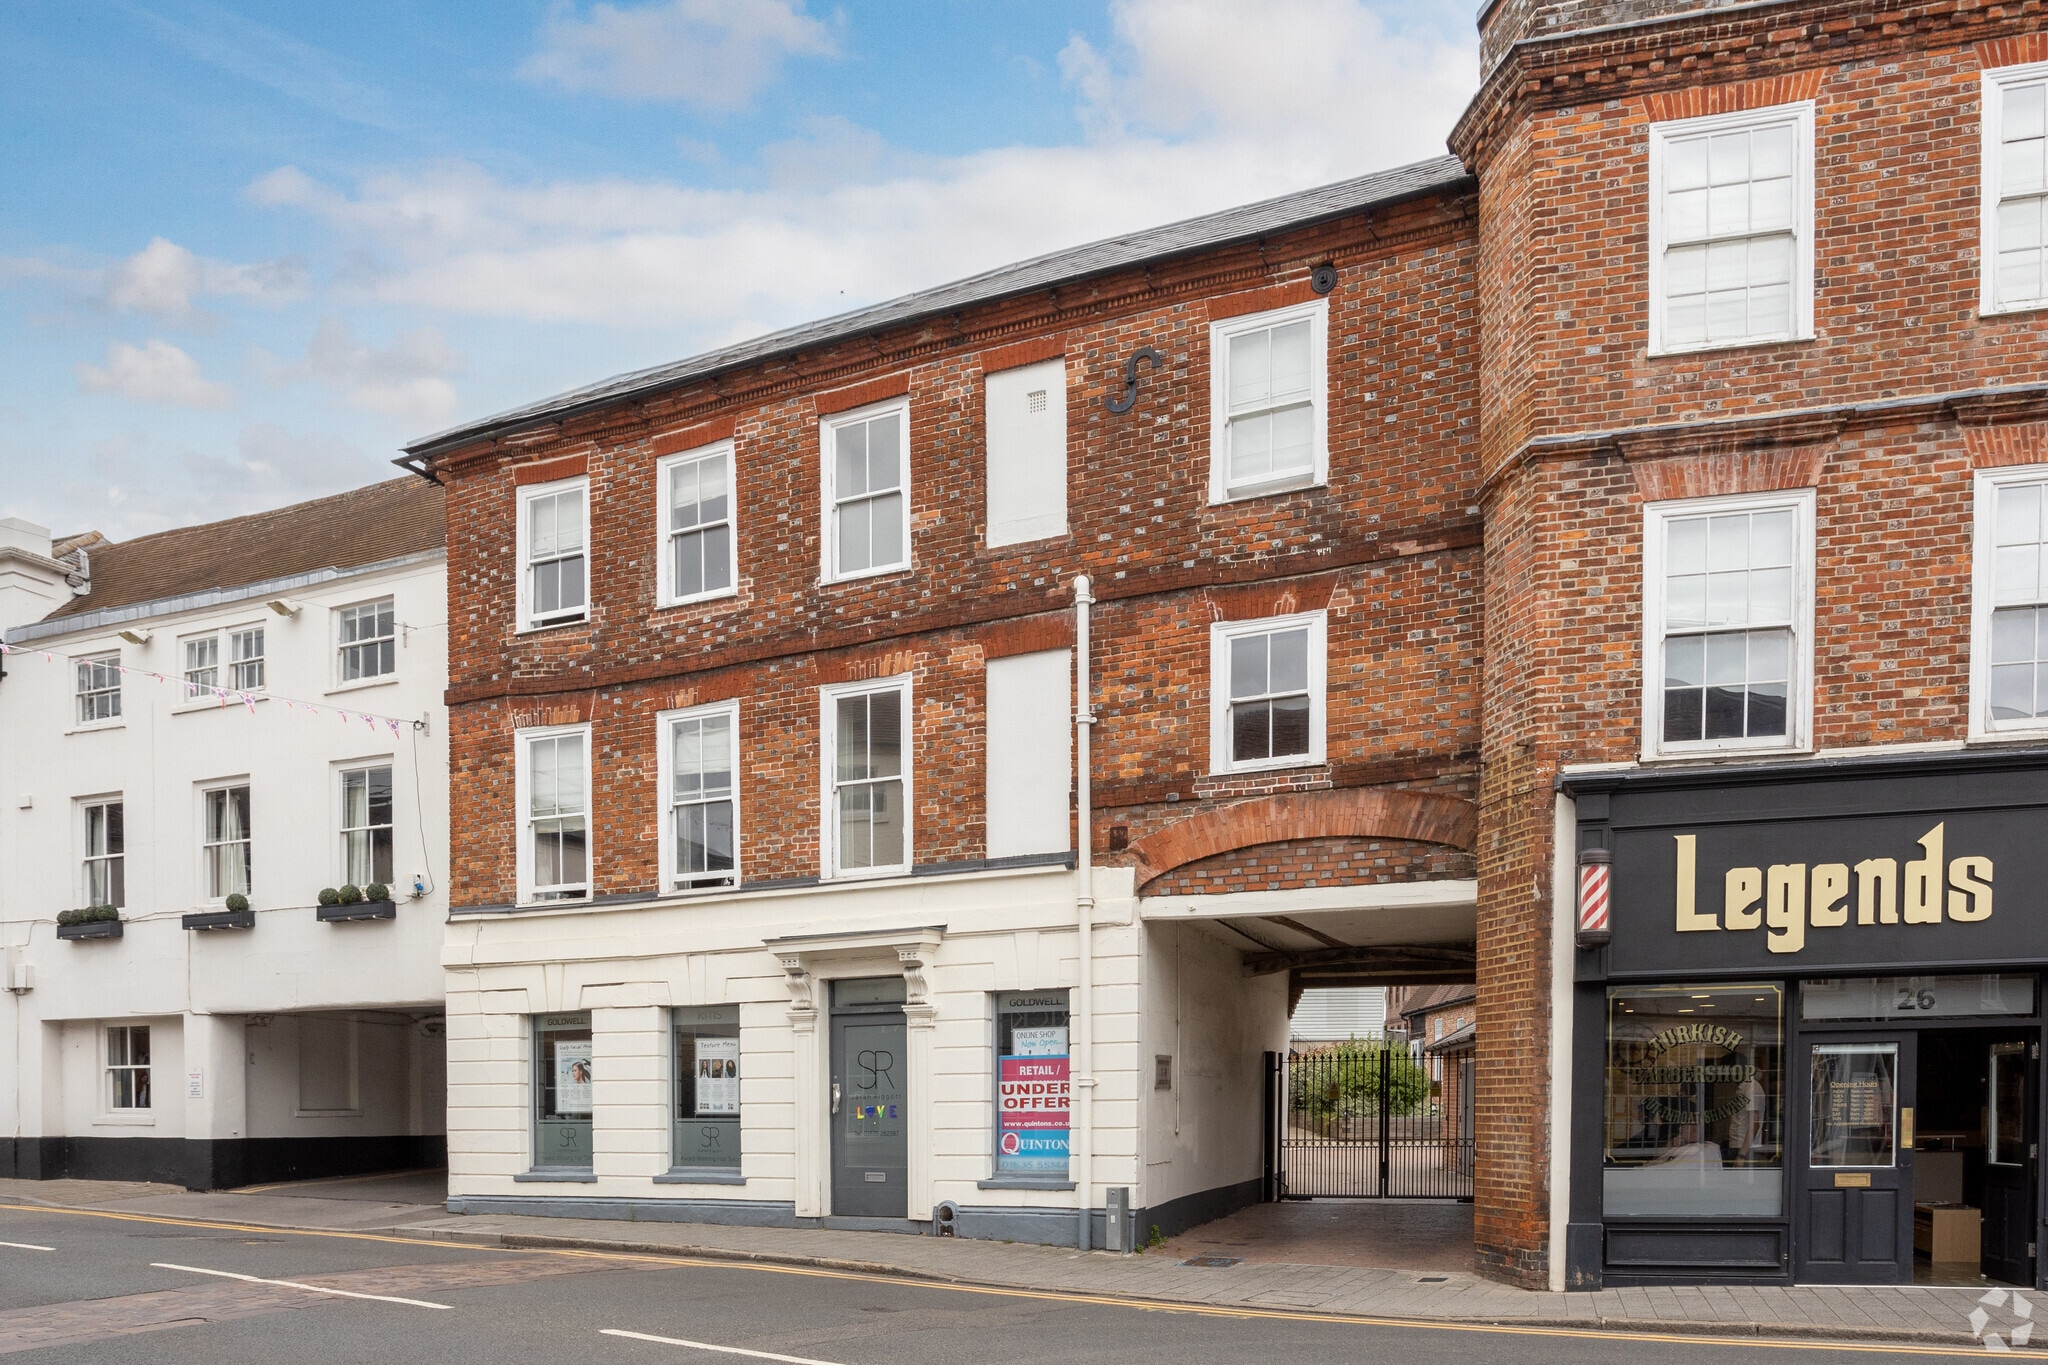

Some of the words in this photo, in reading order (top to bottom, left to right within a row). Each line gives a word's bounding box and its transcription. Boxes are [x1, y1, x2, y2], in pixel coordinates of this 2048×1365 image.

[1673, 821, 1994, 954] Legends
[1898, 987, 1937, 1011] 26
[1016, 1031, 1038, 1040] ONLINE
[1039, 1030, 1056, 1038] SHOP
[1021, 1040, 1037, 1048] Now
[1648, 1023, 1744, 1053] TURKISH
[857, 1049, 895, 1090] SR
[1019, 1065, 1054, 1076] RETAIL
[1056, 1064, 1061, 1076] /
[1632, 1064, 1757, 1085] BARBERSHOP
[1001, 1082, 1070, 1096] UNDER
[1830, 1081, 1858, 1089] Opening
[1003, 1096, 1070, 1110] OFFER
[1704, 1093, 1751, 1124] SHAVING
[559, 1126, 577, 1148] SR
[701, 1126, 720, 1148] SR
